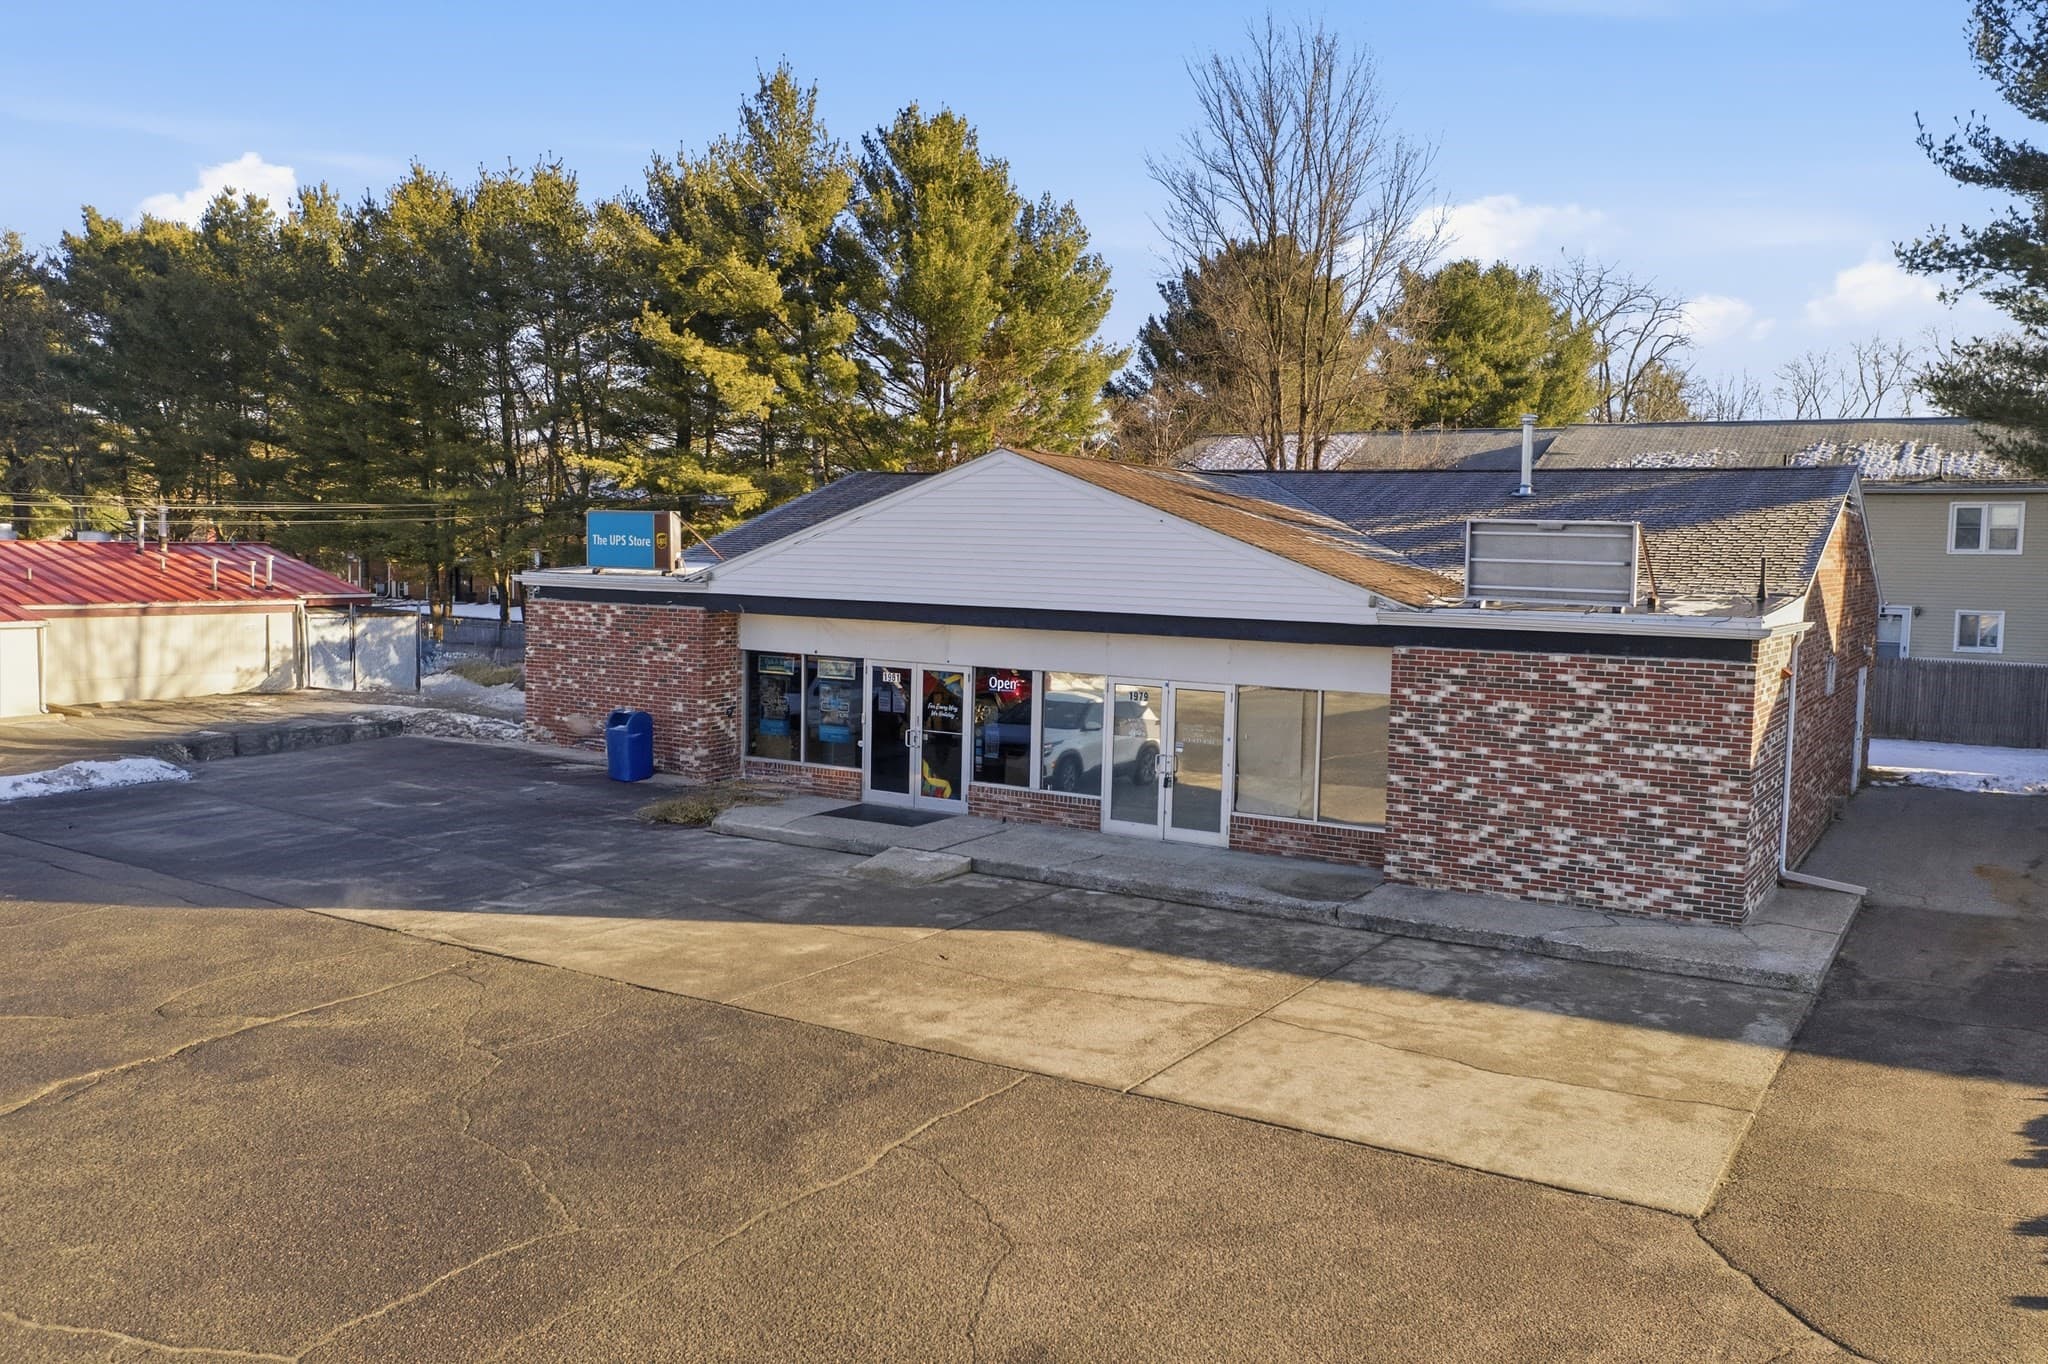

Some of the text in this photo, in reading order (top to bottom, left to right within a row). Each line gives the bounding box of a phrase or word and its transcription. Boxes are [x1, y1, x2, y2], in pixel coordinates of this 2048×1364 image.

[592, 534, 607, 545] The
[609, 535, 626, 546] UPS
[628, 535, 651, 547] Store
[989, 676, 1017, 692] Open
[1129, 691, 1149, 701] 1979
